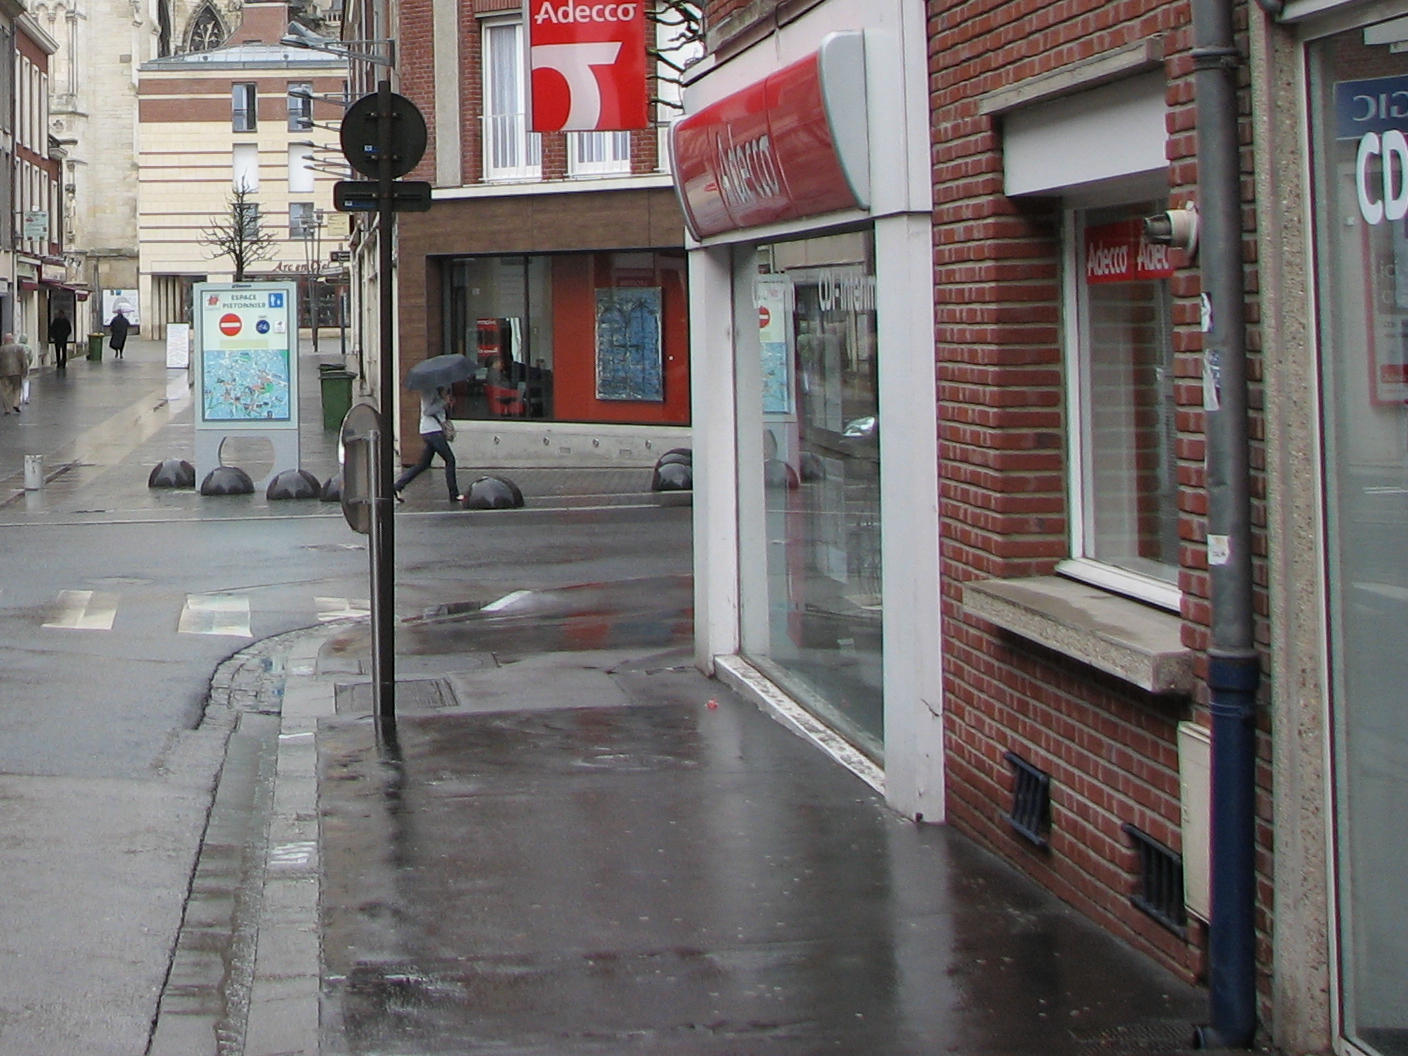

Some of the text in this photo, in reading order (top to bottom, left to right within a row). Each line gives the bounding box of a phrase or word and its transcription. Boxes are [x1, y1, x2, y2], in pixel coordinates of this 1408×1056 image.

[534, 0, 638, 25] Adecco
[716, 124, 780, 205] Adecco
[1086, 241, 1128, 277] Adecco
